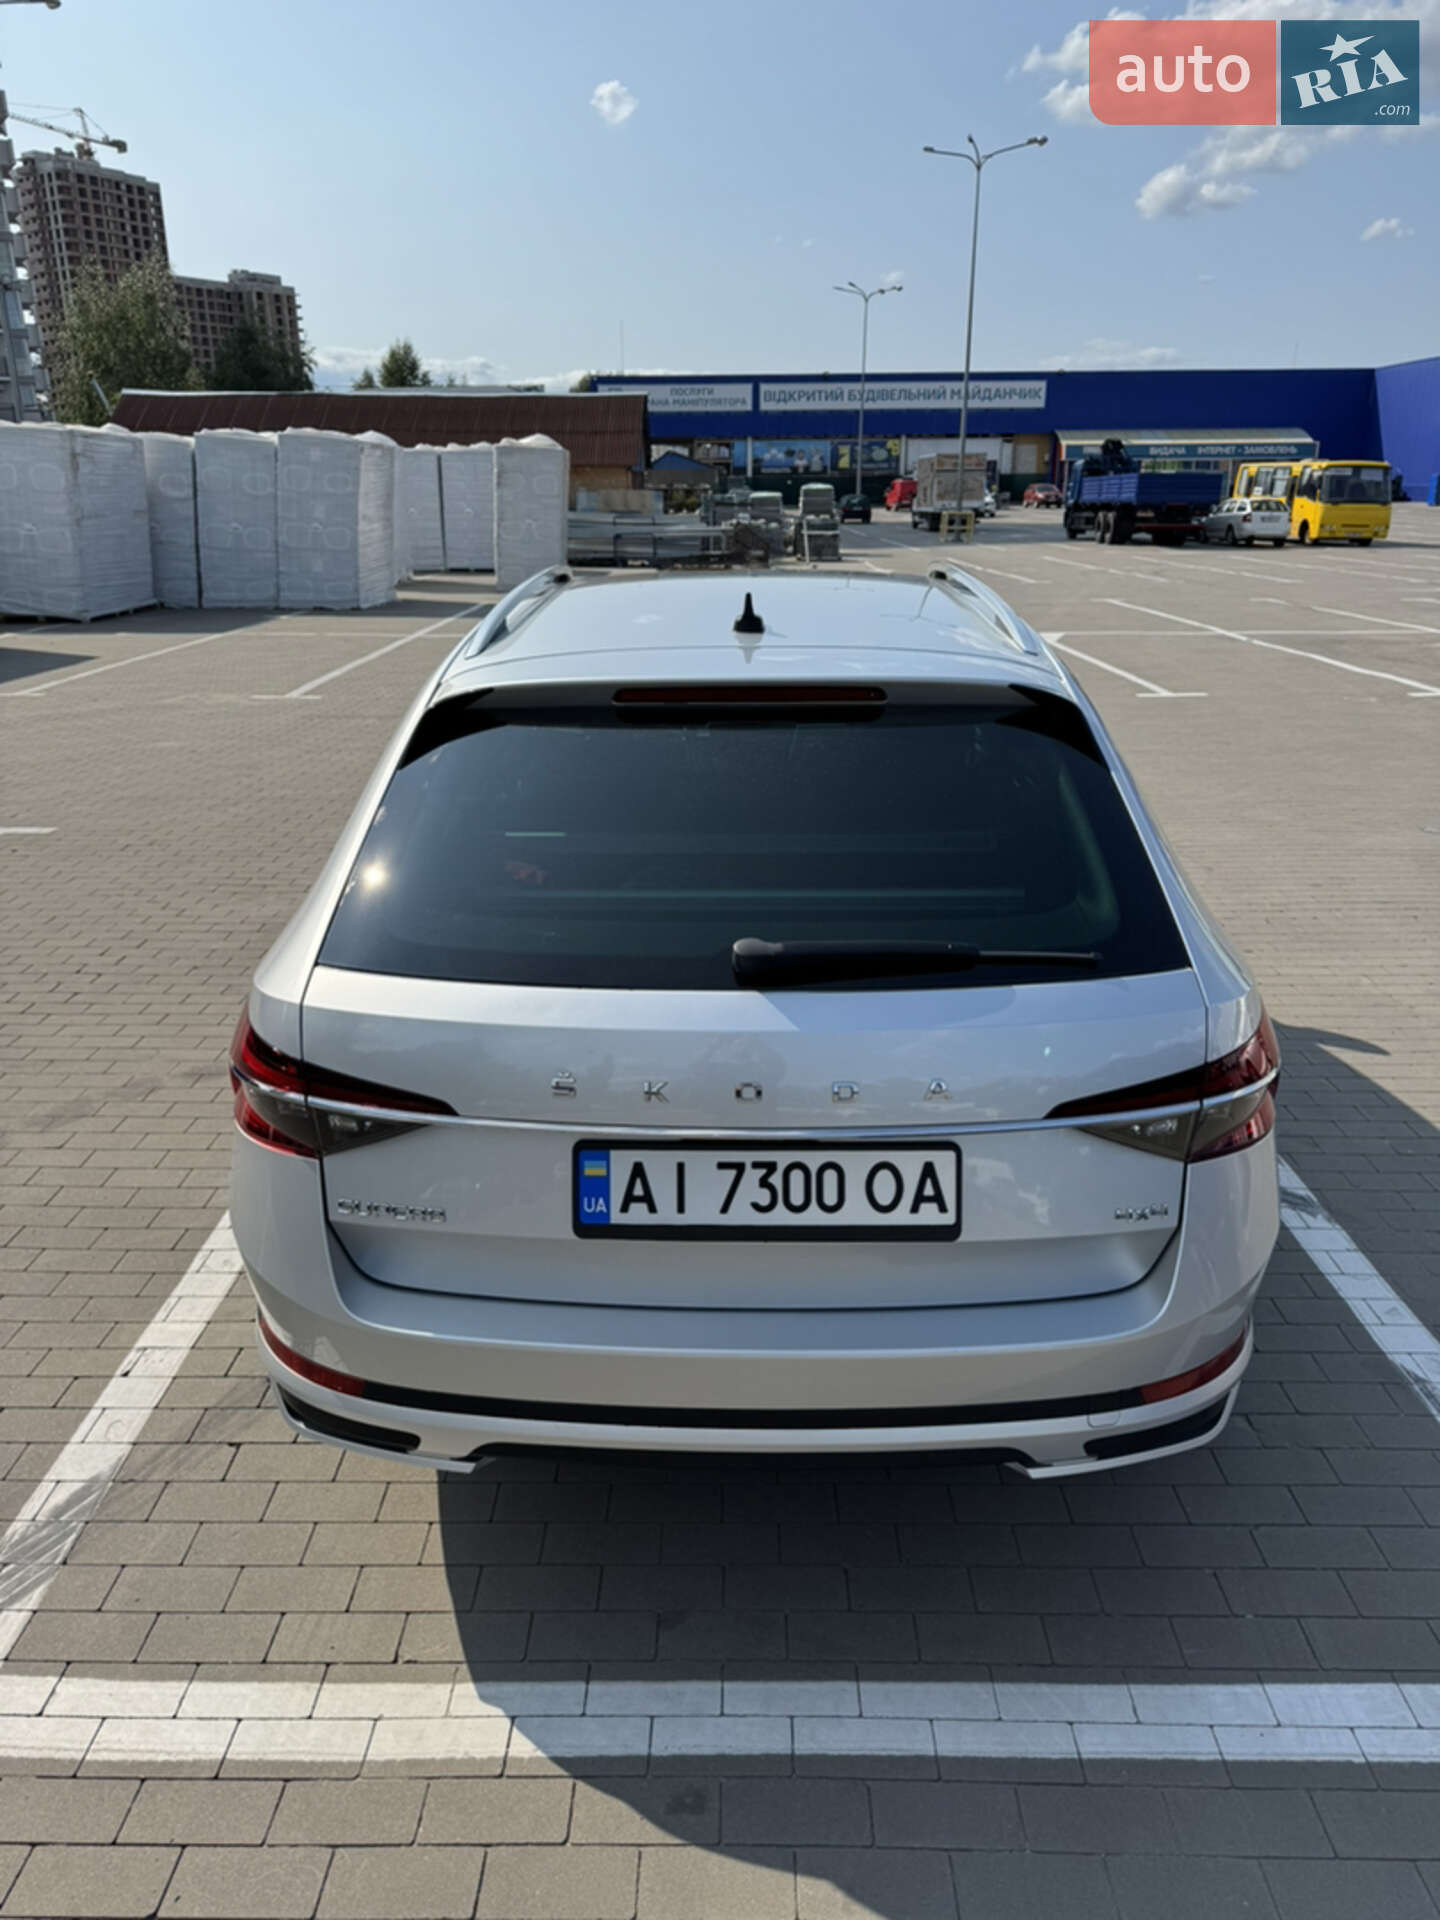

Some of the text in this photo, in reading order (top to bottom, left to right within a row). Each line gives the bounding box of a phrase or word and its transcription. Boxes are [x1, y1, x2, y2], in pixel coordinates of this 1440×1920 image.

[670, 387, 715, 396] ПОСЛУГИ
[763, 386, 845, 405] ВІДКРИТИЙ
[847, 384, 946, 403] БУДІВЕЛЬНИЙ
[619, 1161, 949, 1214] AI 7300 OA
[583, 1197, 607, 1213] UA
